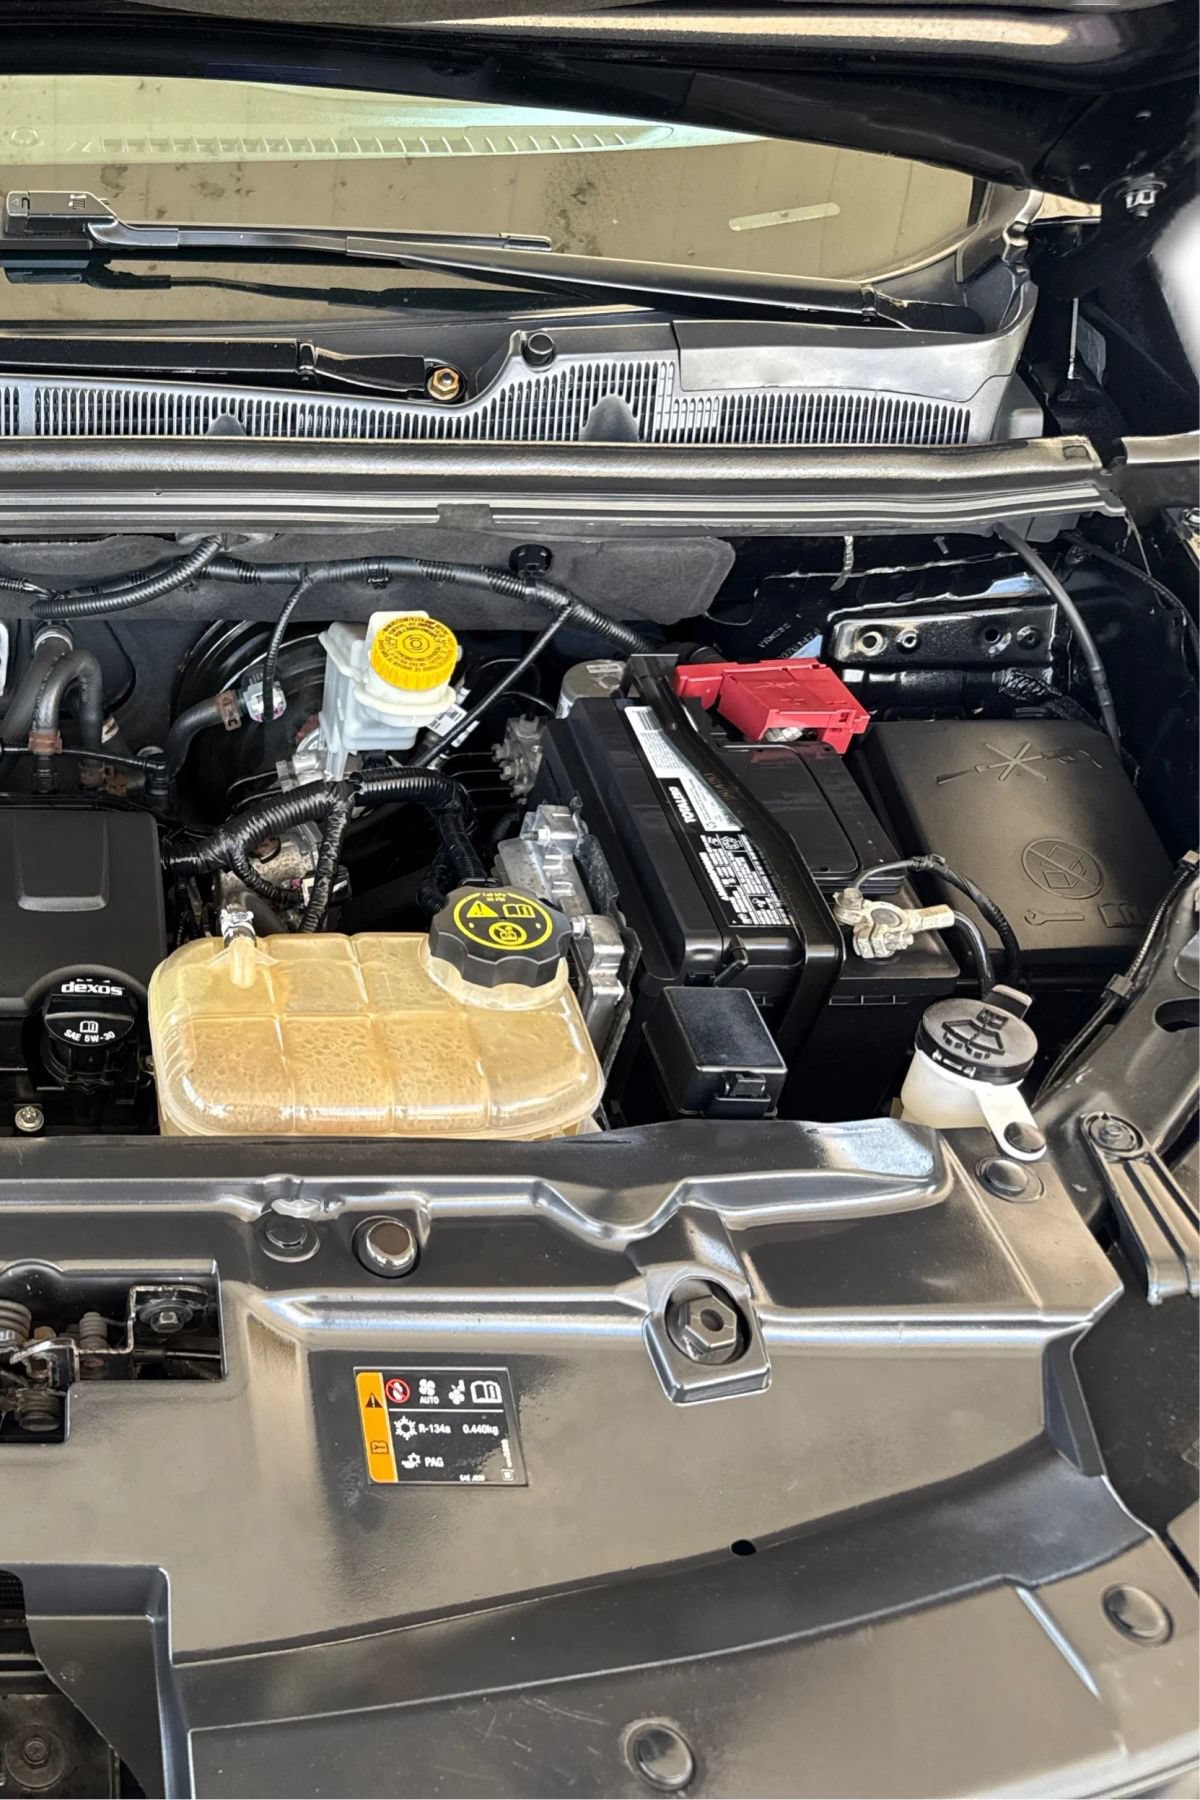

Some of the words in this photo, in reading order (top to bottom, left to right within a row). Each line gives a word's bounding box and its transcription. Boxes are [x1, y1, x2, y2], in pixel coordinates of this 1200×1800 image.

[61, 981, 123, 996] dexos
[63, 1029, 82, 1042] SAE
[84, 1030, 116, 1043] 5W-30
[419, 1396, 440, 1405] AUTO
[418, 1423, 452, 1434] R-134a
[462, 1423, 499, 1437] 0.440kg
[424, 1456, 444, 1467] PAG
